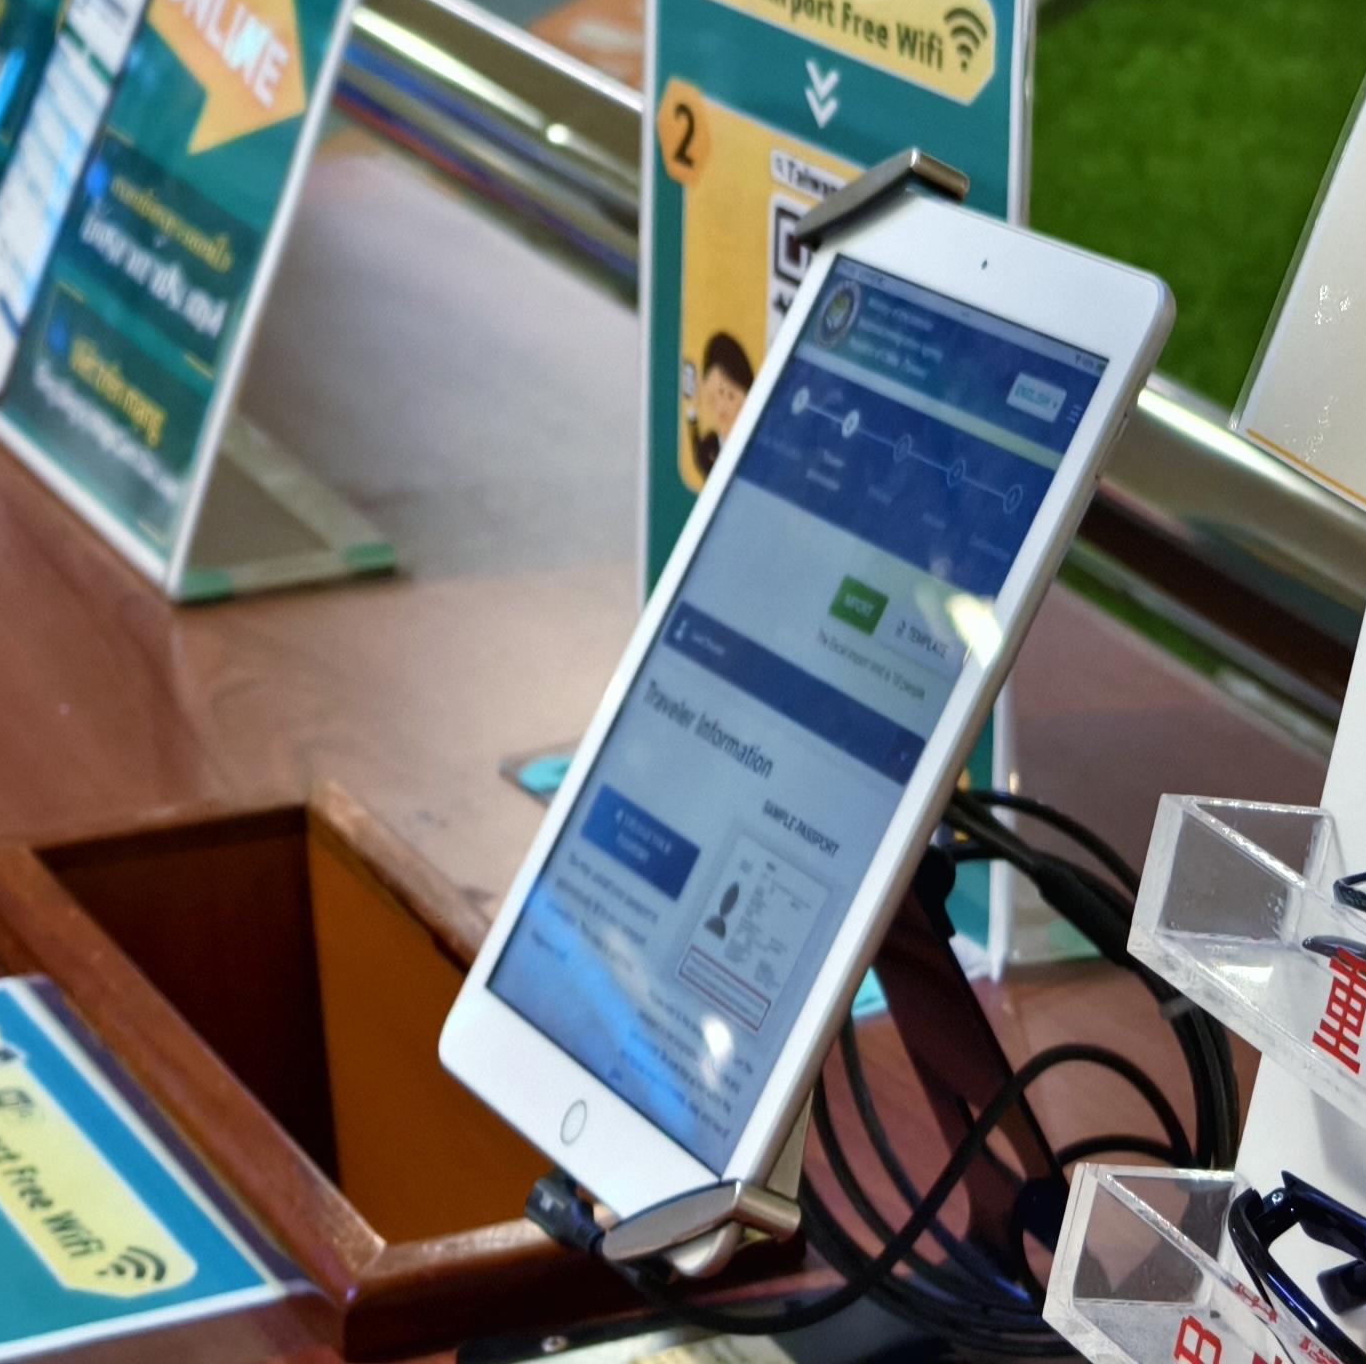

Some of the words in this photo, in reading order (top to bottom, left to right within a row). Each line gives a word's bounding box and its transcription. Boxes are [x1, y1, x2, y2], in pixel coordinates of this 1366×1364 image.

[842, 1, 889, 50] Free
[896, 22, 944, 71] Wifi
[674, 103, 695, 168] 2
[642, 679, 696, 729] Traveler
[694, 712, 774, 779] Information
[1, 1166, 53, 1210] Free
[43, 1210, 105, 1258] Wifi
